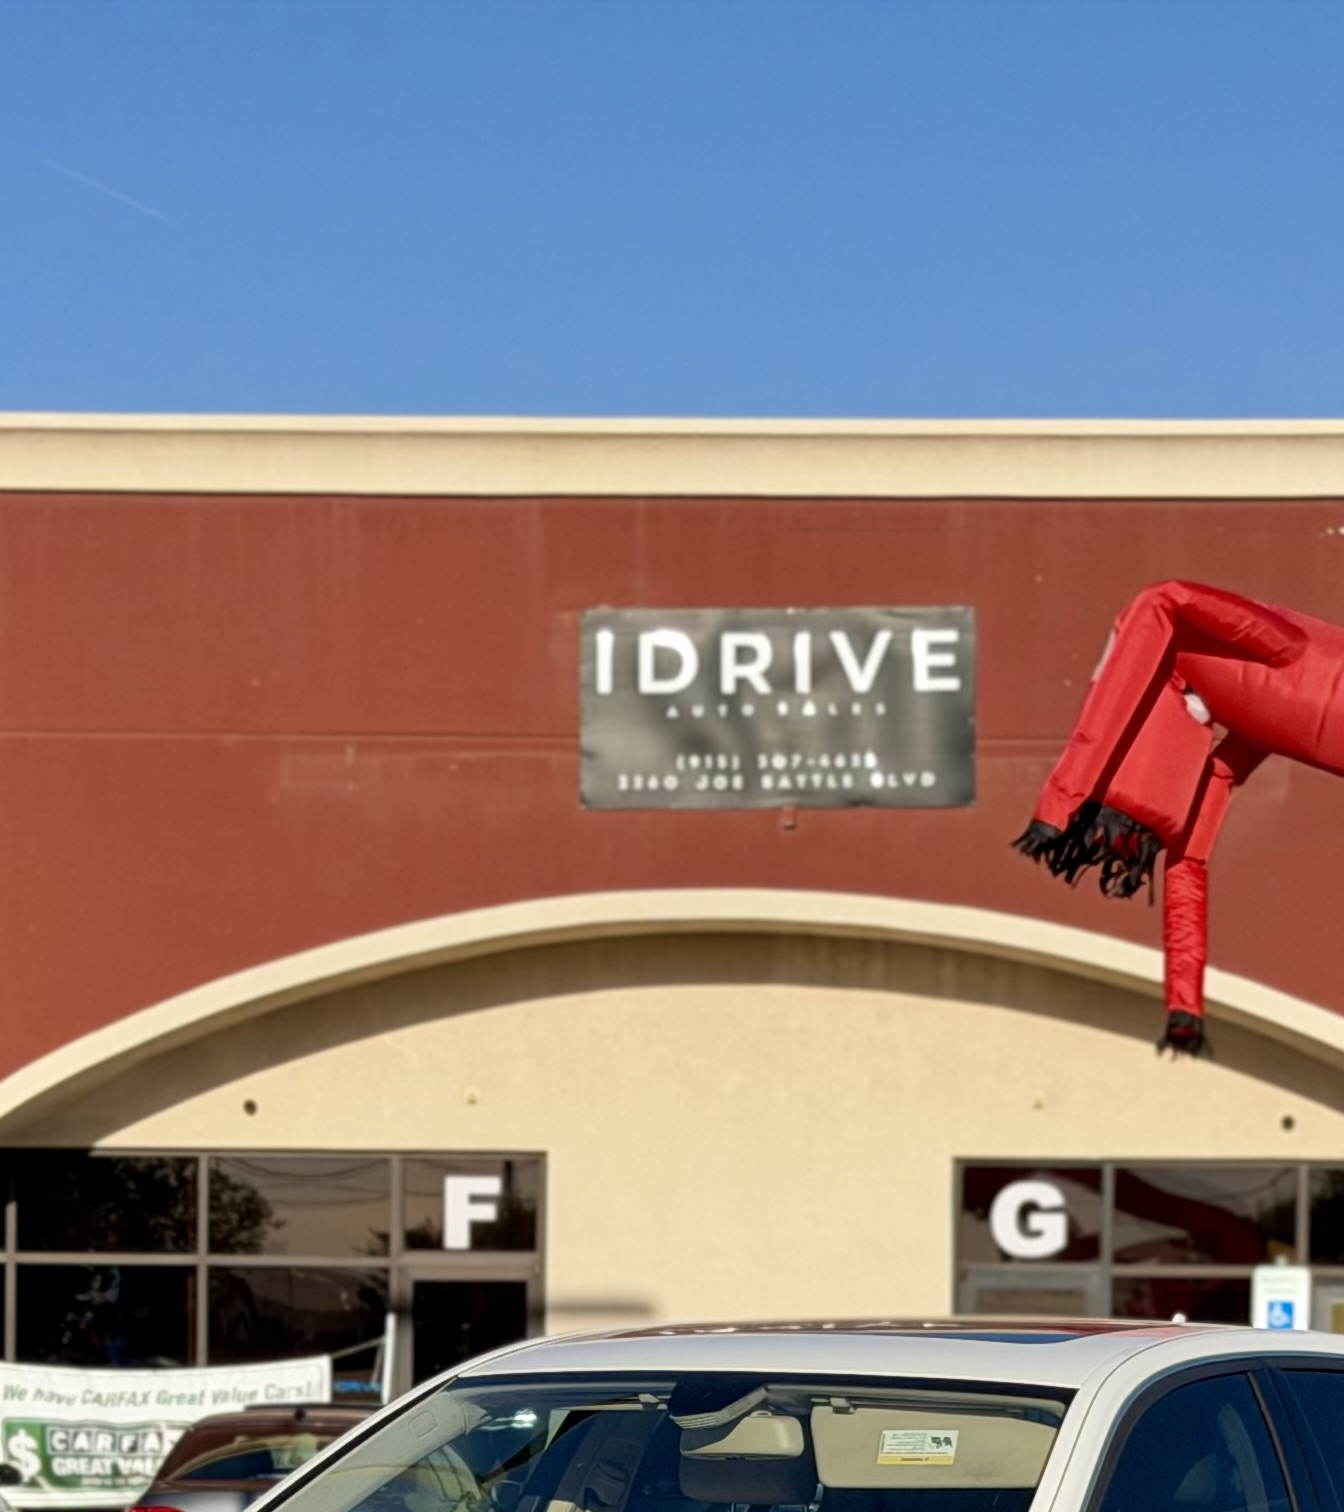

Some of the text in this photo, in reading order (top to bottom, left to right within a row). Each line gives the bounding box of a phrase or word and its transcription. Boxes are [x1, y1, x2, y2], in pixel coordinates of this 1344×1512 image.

[595, 627, 961, 695] IDRIVE
[665, 700, 887, 719] AUTO SALES
[695, 774, 744, 791] JOE
[761, 773, 854, 790] BATTLE
[443, 1175, 502, 1250] F
[989, 1179, 1068, 1260] G
[3, 1385, 29, 1402] We
[33, 1387, 76, 1407] have
[81, 1388, 151, 1409] CARFAX
[156, 1388, 206, 1407] Great
[211, 1386, 259, 1406] Value
[264, 1380, 313, 1401] Cars!
[51, 1456, 113, 1476] GREAT
